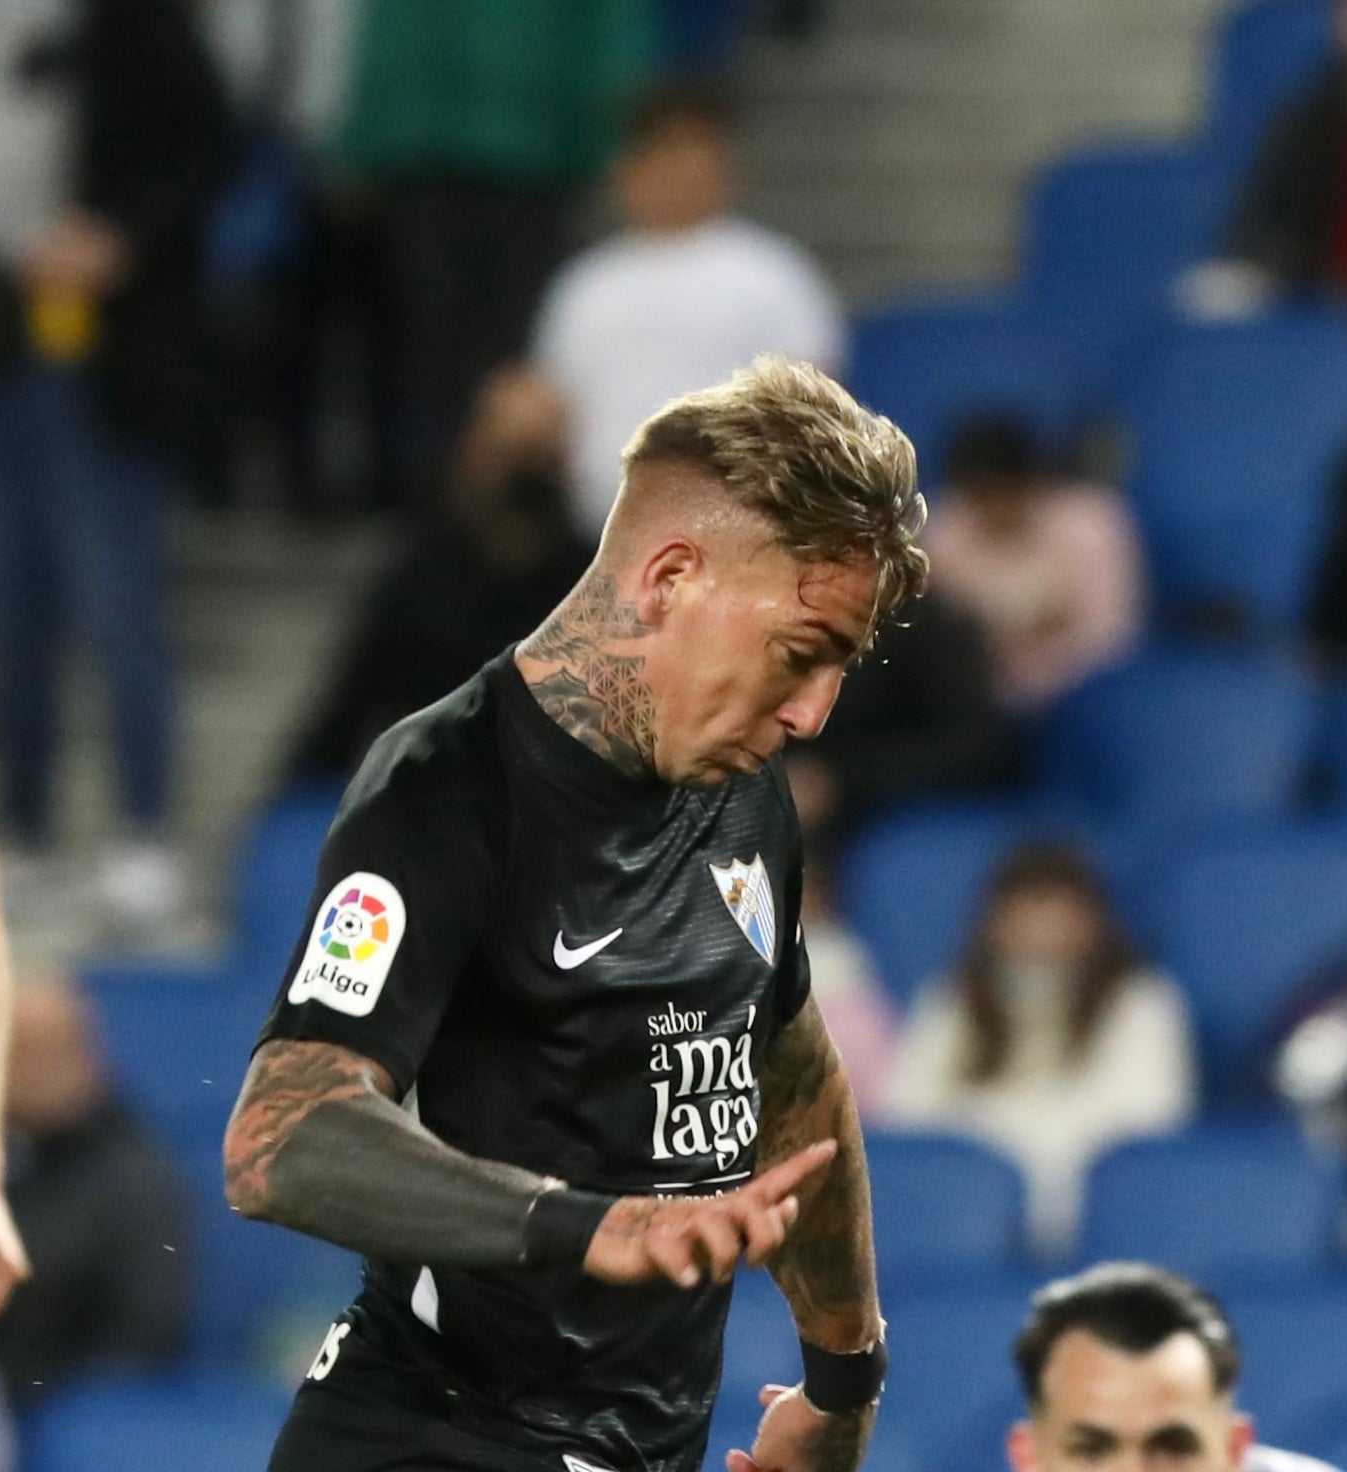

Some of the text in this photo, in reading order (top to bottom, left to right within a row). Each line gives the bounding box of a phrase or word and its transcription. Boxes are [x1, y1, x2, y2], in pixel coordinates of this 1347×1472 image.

[647, 1001, 707, 1037] sabor
[649, 1004, 756, 1097] a má
[650, 1079, 758, 1172] laga
